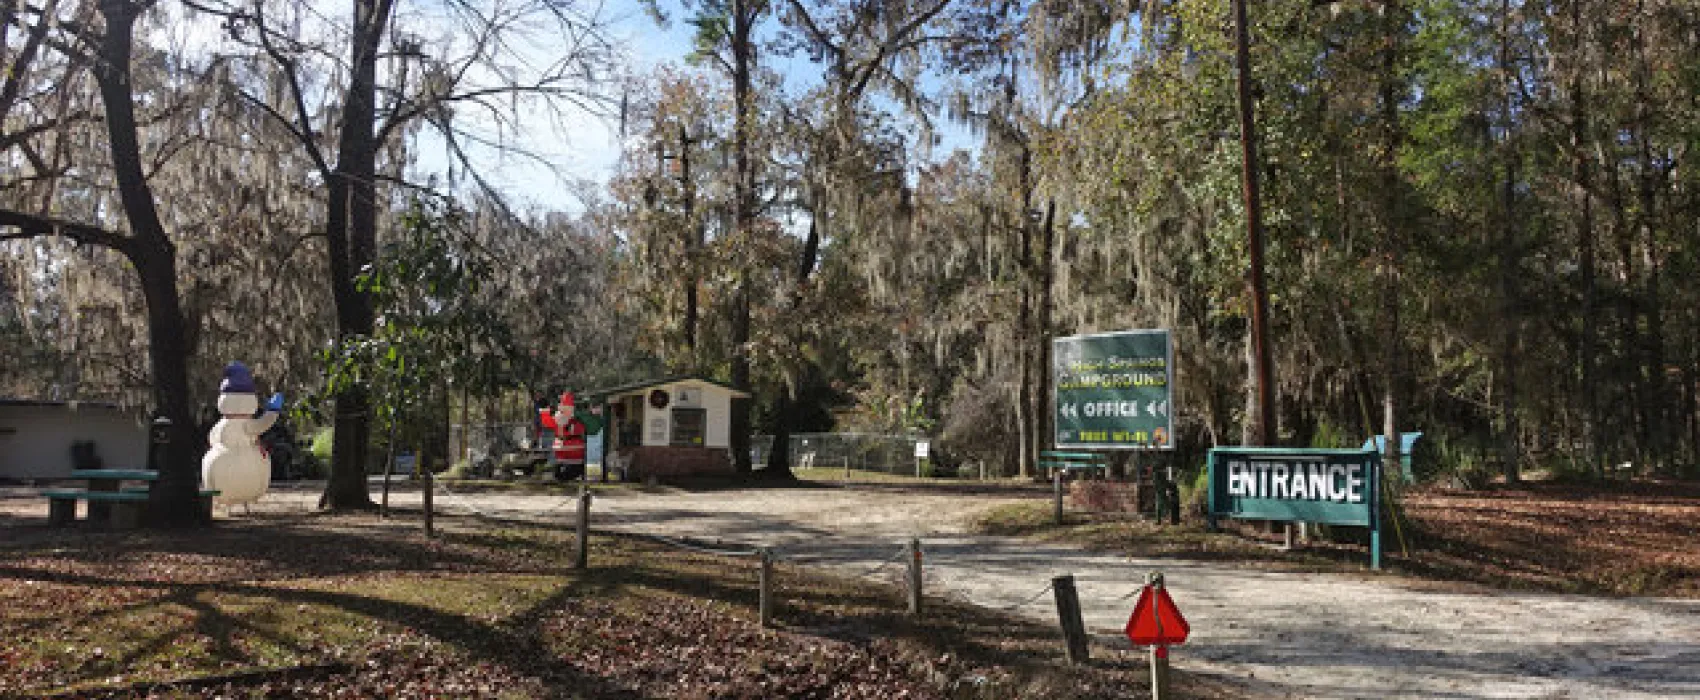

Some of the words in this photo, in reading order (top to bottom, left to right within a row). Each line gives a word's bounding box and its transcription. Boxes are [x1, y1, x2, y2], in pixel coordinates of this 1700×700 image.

[1058, 372, 1167, 388] CAMPGROUND
[1083, 400, 1138, 417] OFFICE
[1227, 461, 1361, 502] ENTRANCE
